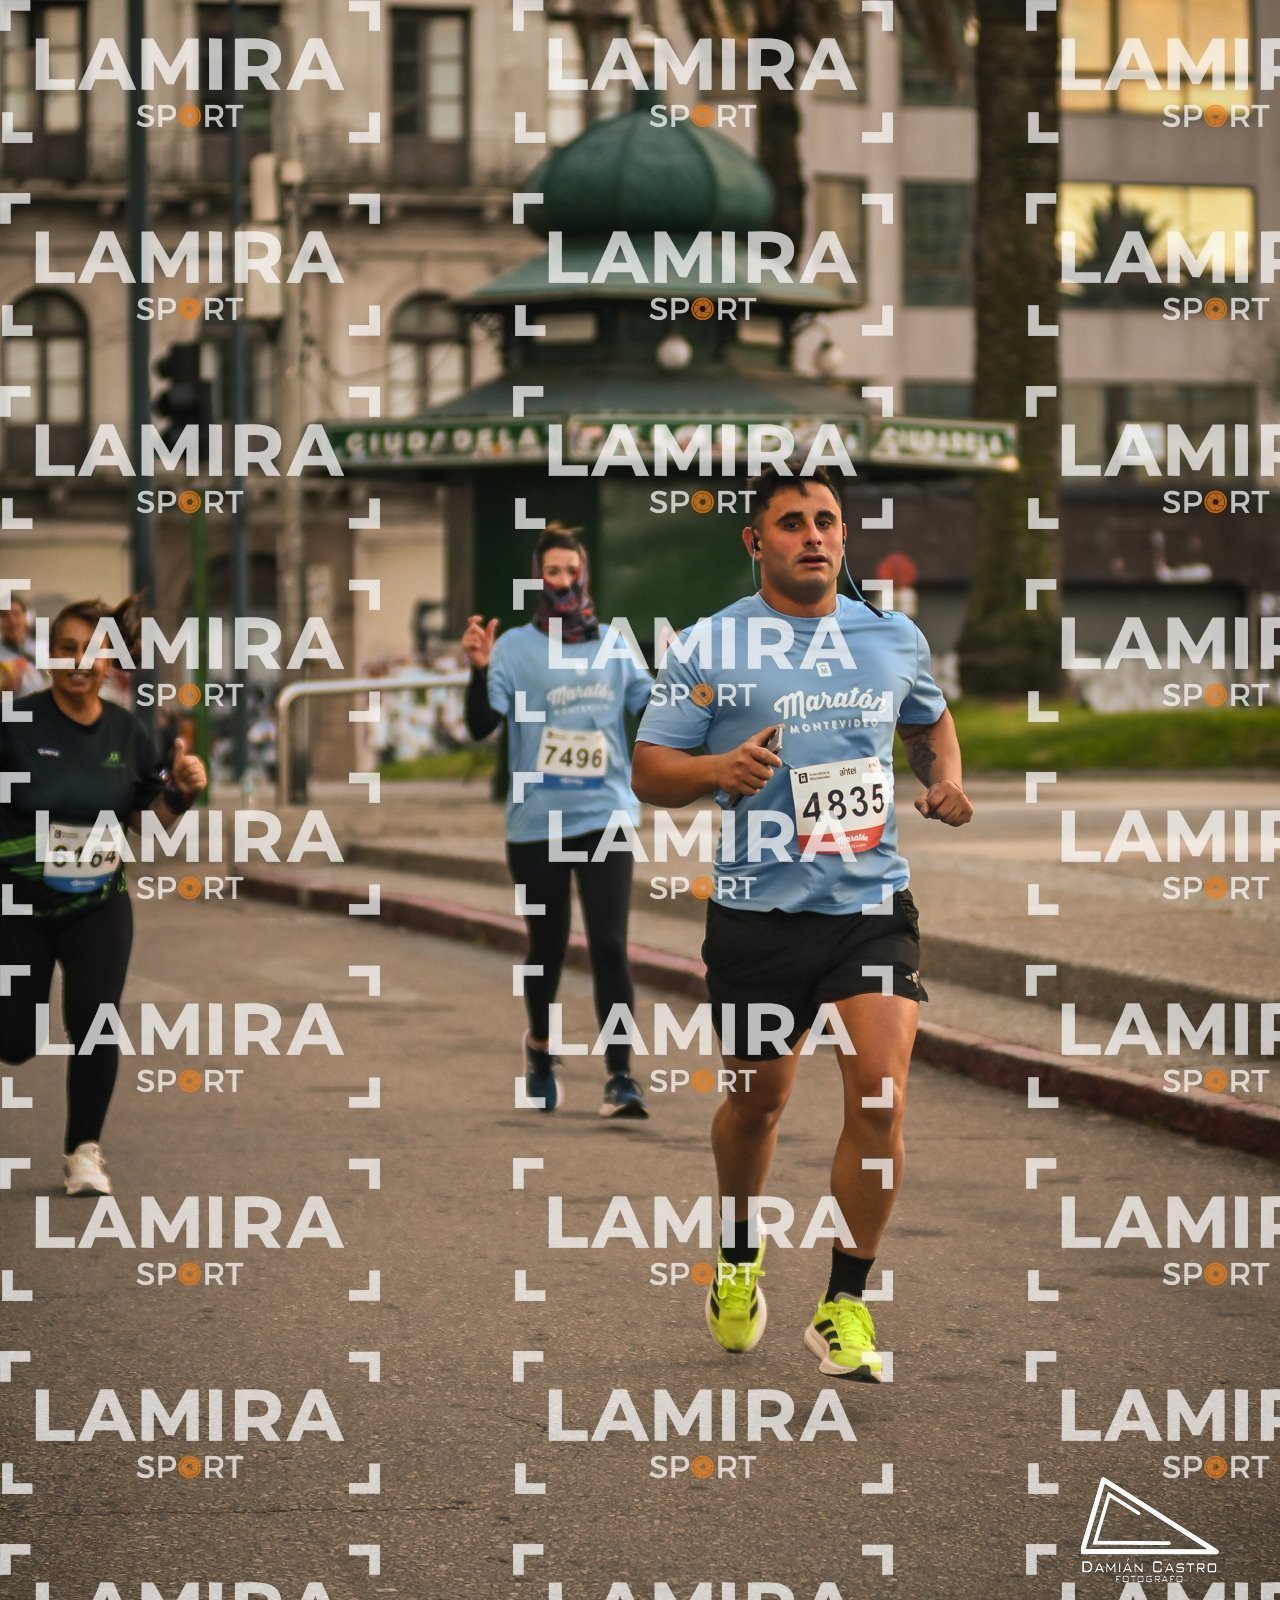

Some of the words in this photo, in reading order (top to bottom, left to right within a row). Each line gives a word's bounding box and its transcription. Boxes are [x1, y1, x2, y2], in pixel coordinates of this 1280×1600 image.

[773, 687, 887, 720] Maratón
[789, 717, 879, 735] MONTEVIDEO
[544, 744, 603, 769] 7496
[803, 783, 885, 823] 4835
